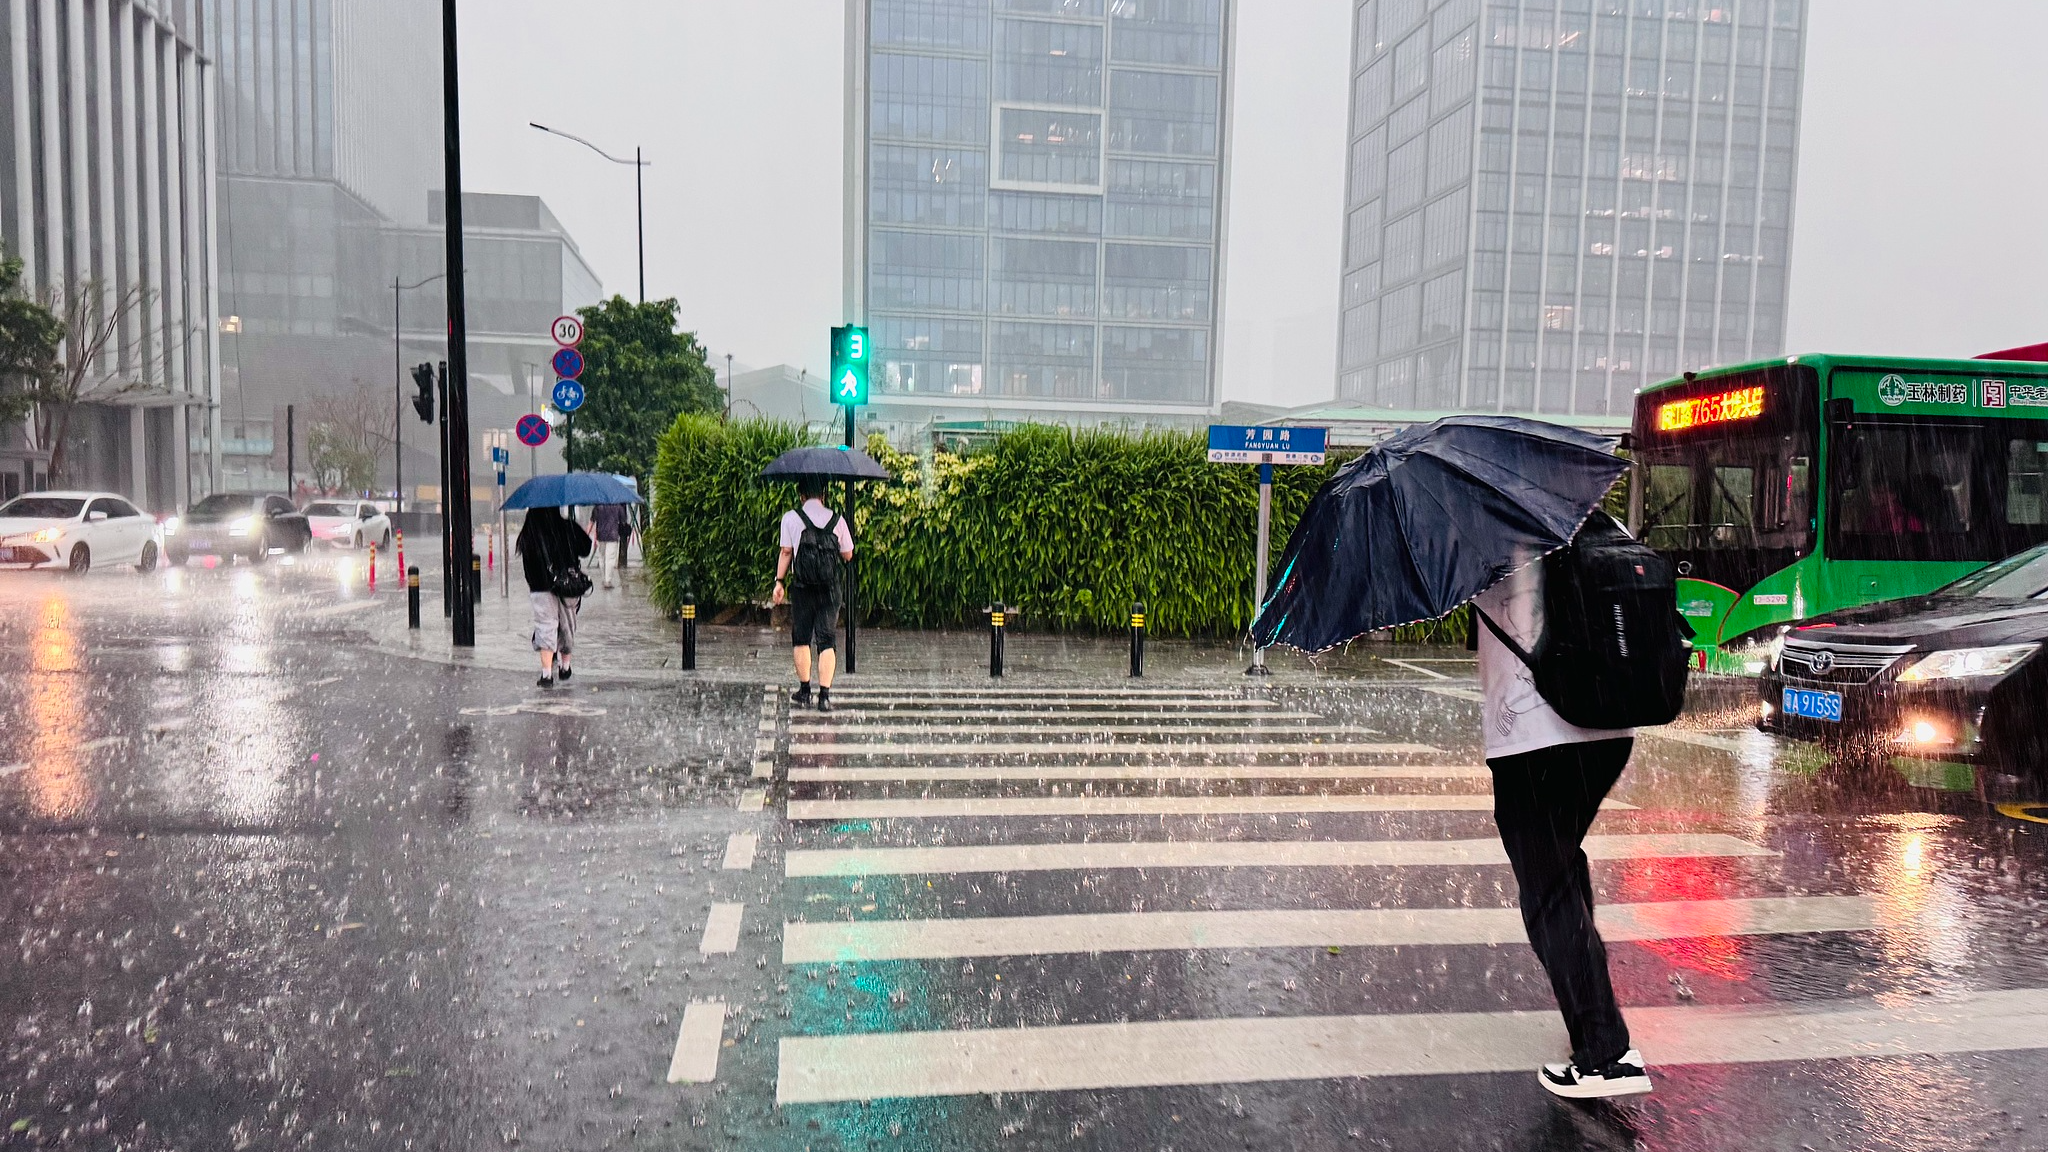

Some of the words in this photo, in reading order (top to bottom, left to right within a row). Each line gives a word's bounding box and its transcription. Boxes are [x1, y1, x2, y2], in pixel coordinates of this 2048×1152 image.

[559, 324, 576, 339] 30
[851, 334, 863, 359] 3
[1906, 383, 1967, 403] 玉林制药
[1245, 441, 1279, 450] FANGYUAN
[1282, 442, 1290, 450] LU
